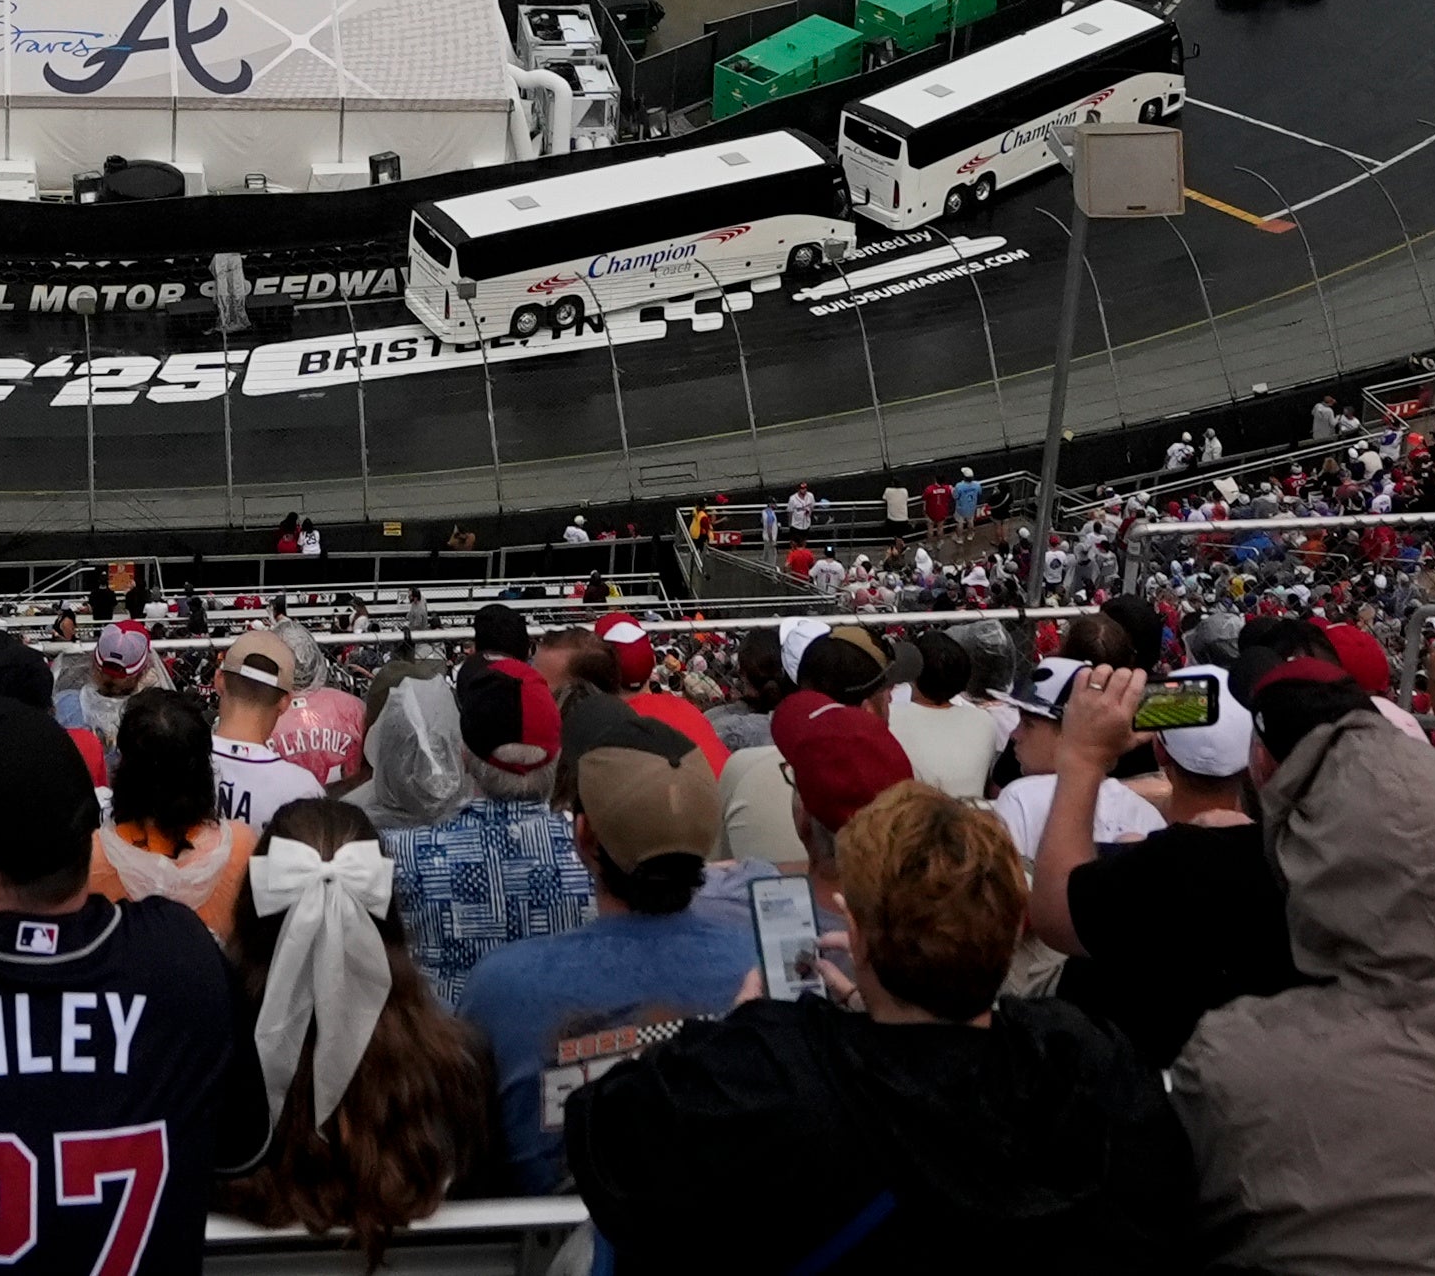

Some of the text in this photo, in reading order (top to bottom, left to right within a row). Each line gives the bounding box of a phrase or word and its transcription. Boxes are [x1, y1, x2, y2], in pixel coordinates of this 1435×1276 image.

[1000, 109, 1077, 155] Champion
[908, 229, 933, 247] by
[588, 243, 698, 279] Champion
[653, 261, 692, 279] Coach
[28, 284, 187, 311] MOTOR
[199, 266, 413, 300] SEEDWA
[809, 249, 1031, 317] BUILDSUBMARINES.COM
[297, 334, 530, 376] BRIST,
[34, 348, 244, 406] '25
[280, 726, 352, 757] LA CRUZ
